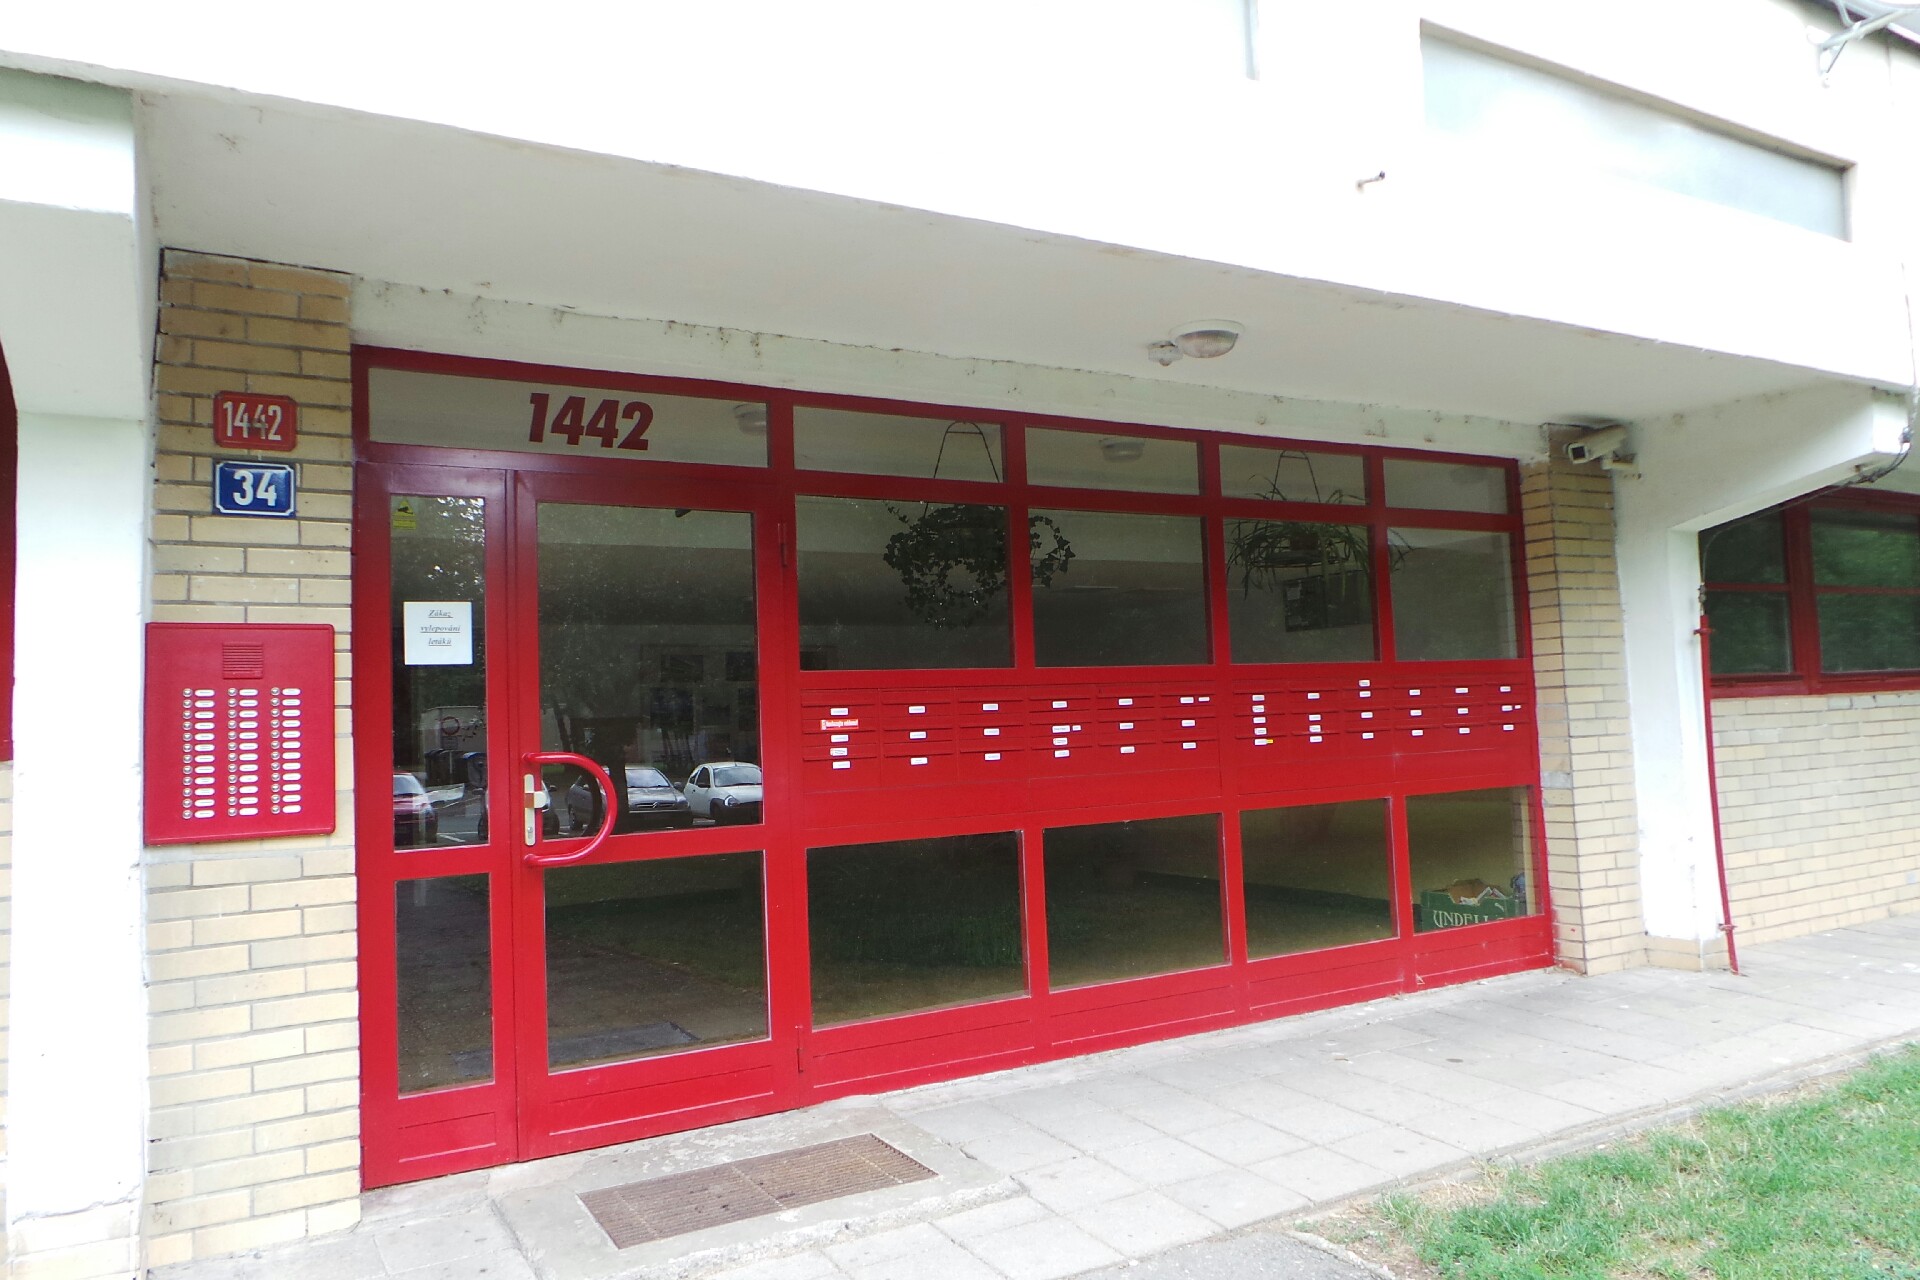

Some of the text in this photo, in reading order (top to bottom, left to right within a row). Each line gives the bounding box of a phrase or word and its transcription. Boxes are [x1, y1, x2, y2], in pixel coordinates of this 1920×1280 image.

[222, 400, 282, 441] 1442
[529, 393, 654, 450] 1442
[232, 469, 278, 507] 34
